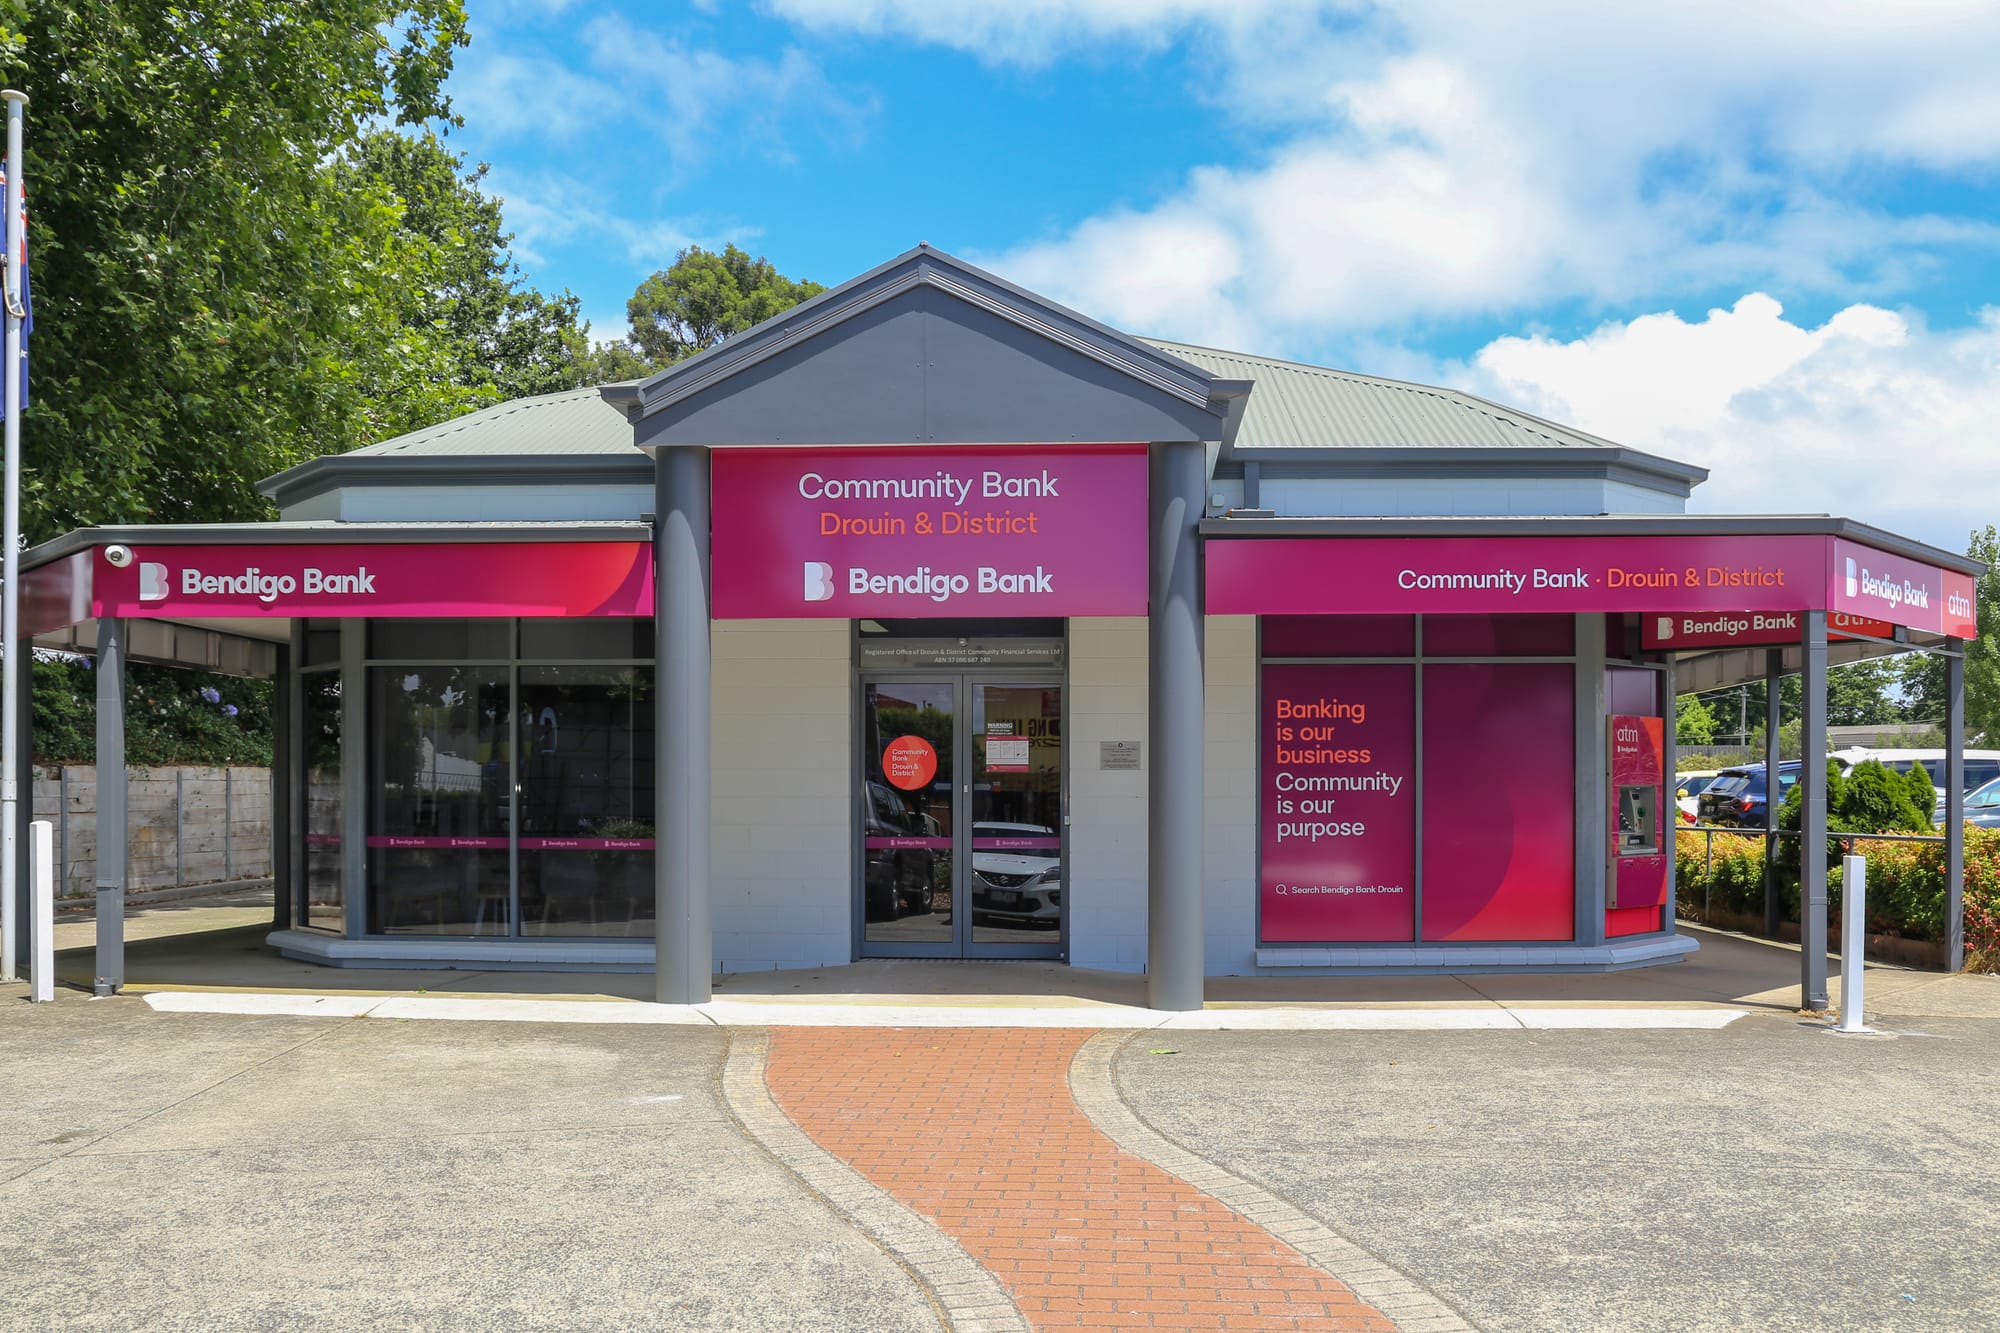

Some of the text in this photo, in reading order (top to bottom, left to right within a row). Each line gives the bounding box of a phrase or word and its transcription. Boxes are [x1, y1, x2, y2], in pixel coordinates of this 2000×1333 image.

[798, 470, 1059, 505] Community Bank
[820, 510, 1038, 536] Drouin & District
[182, 568, 296, 602] Bendigo
[303, 566, 376, 595] Bank
[849, 566, 969, 602] Bendigo
[977, 565, 1054, 594] Bank
[1397, 566, 1785, 595] Community Bank Drouin & District
[1862, 568, 1901, 609] Bendigo
[1904, 580, 1929, 609] Bank
[1948, 589, 1970, 619] atm
[1683, 617, 1748, 636] Bendigo
[1753, 613, 1796, 631] Bank
[865, 648, 895, 656] Registered
[967, 648, 999, 656] Community
[1277, 698, 1366, 723] Banking
[1277, 723, 1335, 741] is our
[1617, 725, 1638, 742] atm
[1277, 745, 1371, 764] business
[1276, 771, 1403, 796] Community
[1277, 796, 1336, 814] is our
[1277, 822, 1365, 843] purpose
[1292, 885, 1403, 895] Search Bendigo Bank Drouin
